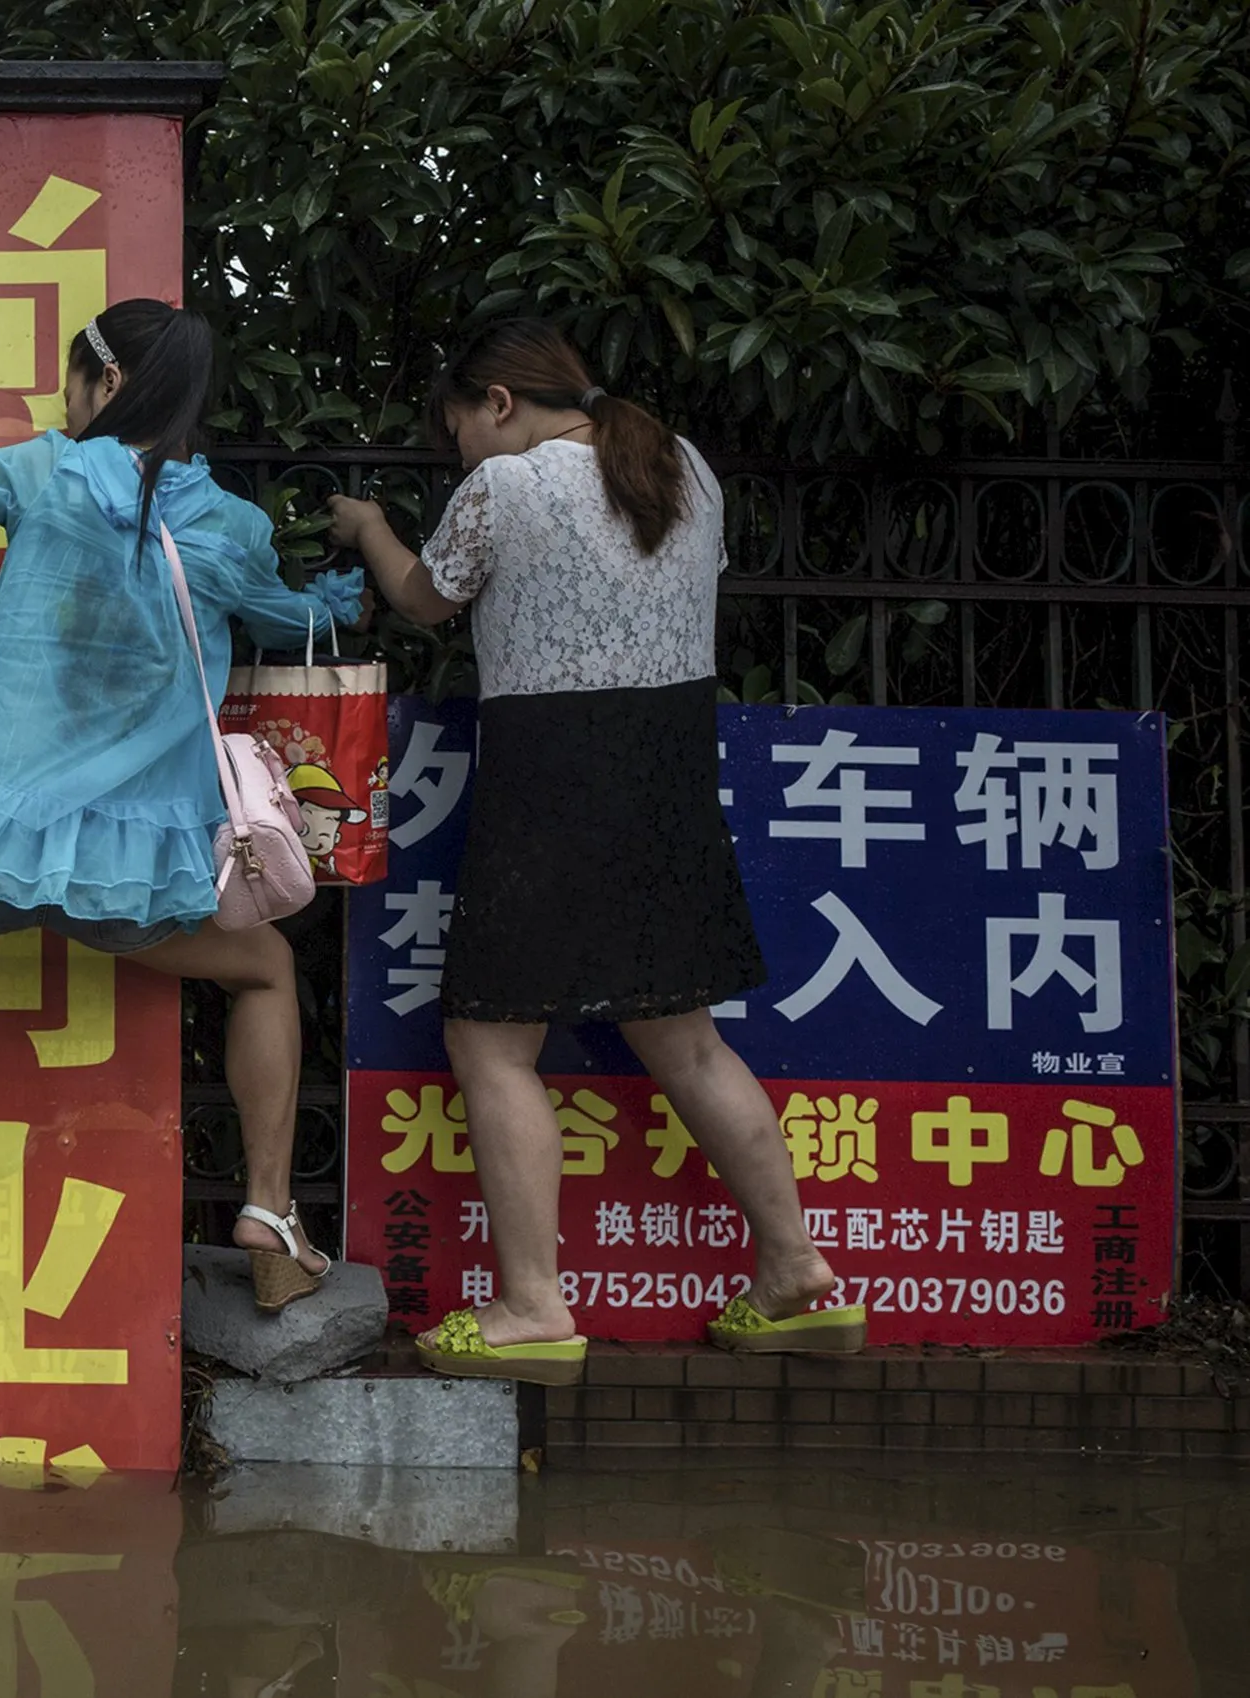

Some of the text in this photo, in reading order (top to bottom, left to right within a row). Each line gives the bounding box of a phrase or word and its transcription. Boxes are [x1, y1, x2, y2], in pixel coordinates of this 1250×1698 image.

[388, 721, 1119, 870] 外车辆
[378, 880, 1123, 1034] 入内
[1032, 1052, 1125, 1075] 物业宣
[560, 1271, 752, 1310] 87525042
[1091, 1204, 1139, 1329] 工商注册
